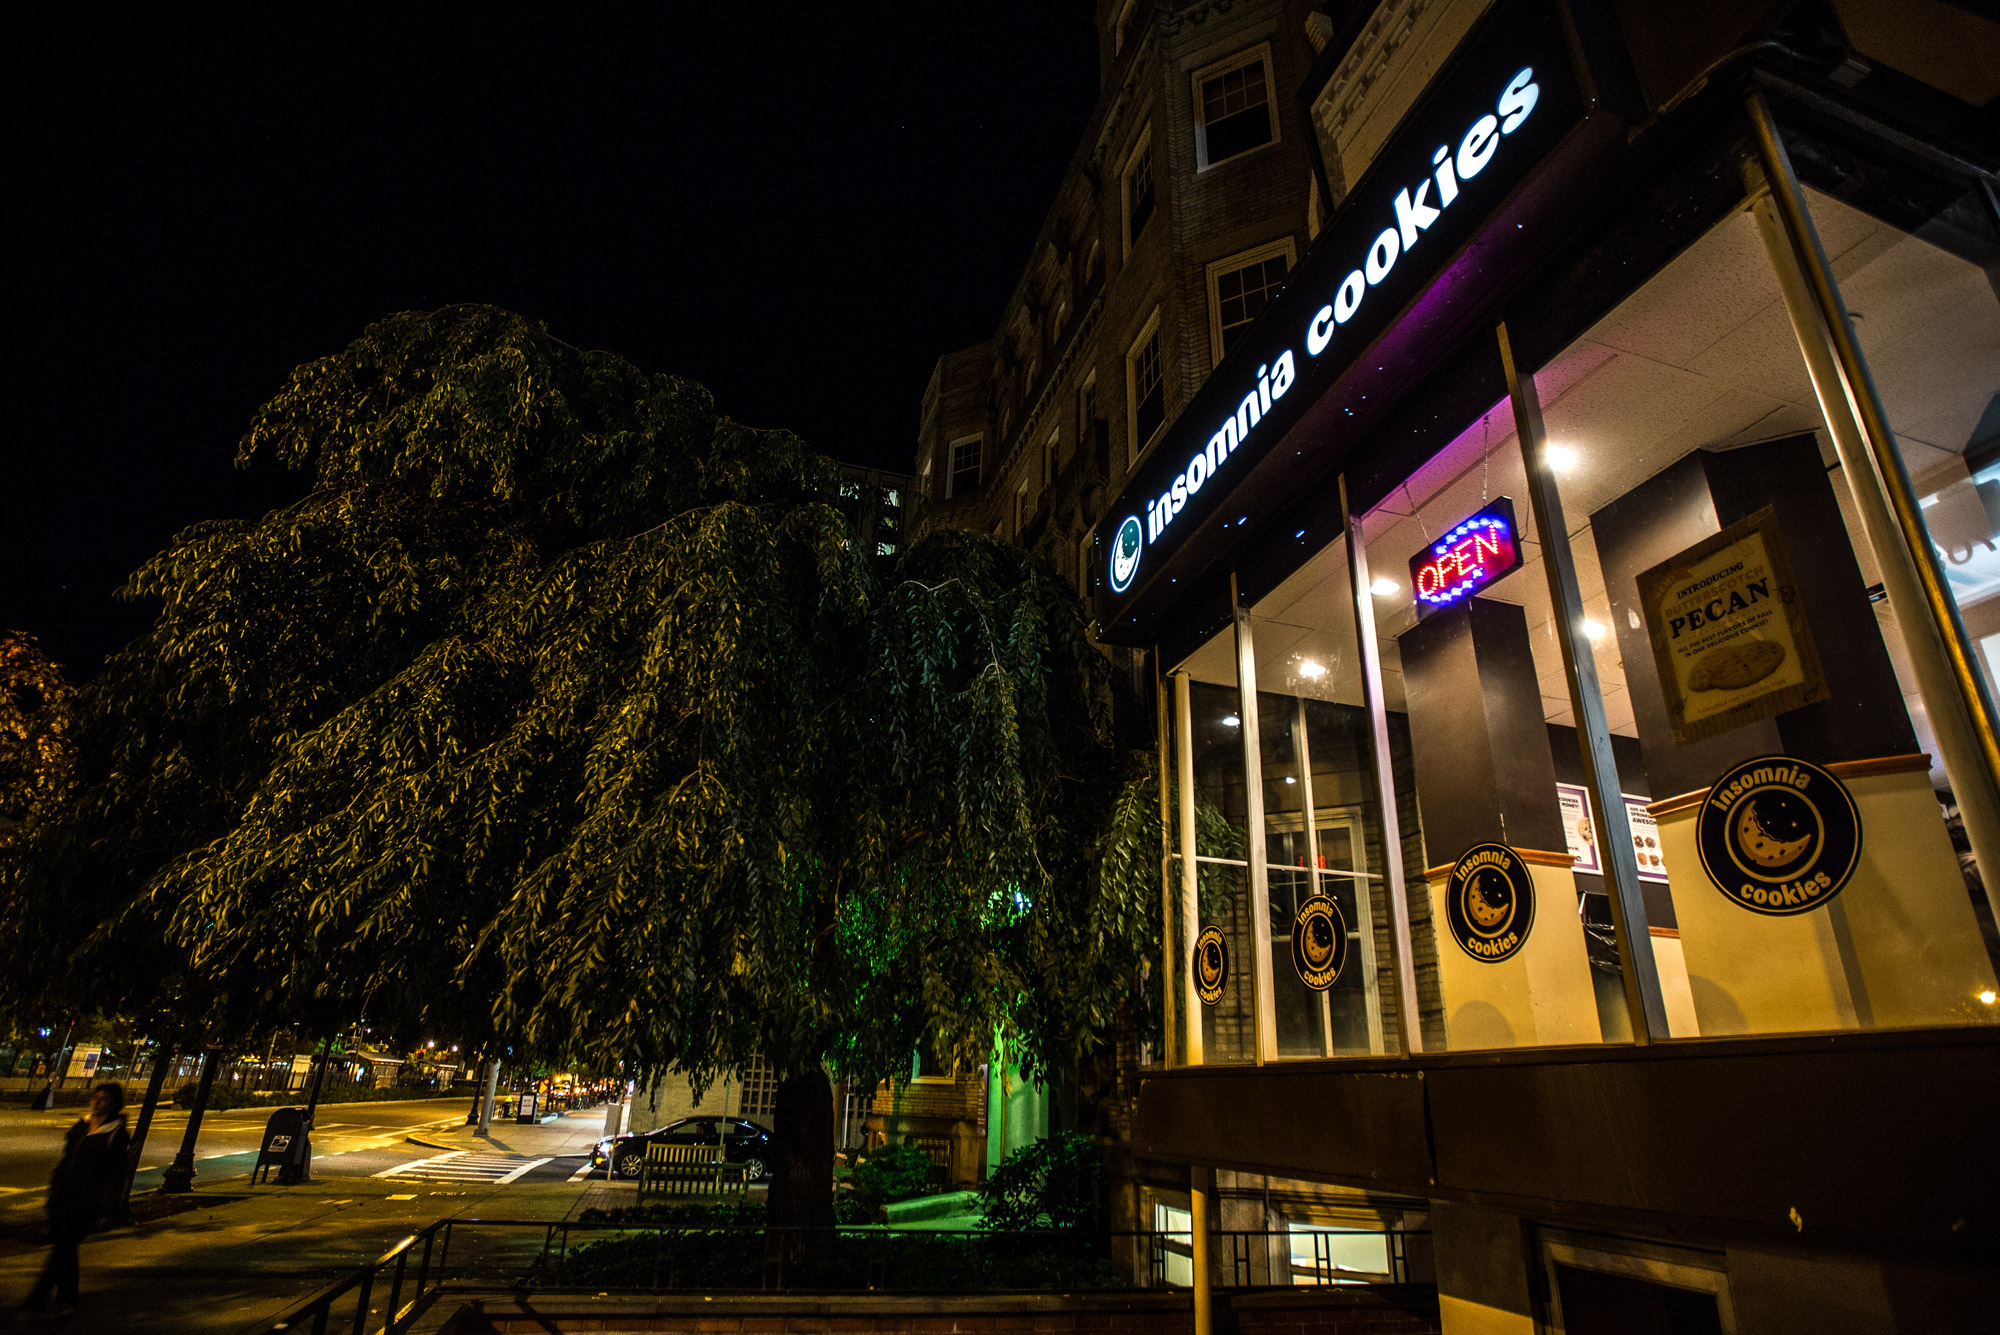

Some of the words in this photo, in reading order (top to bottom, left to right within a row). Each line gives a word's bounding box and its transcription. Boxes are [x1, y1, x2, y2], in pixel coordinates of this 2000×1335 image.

[1147, 348, 1296, 544] insomnia
[1305, 65, 1541, 357] cookies
[1417, 523, 1499, 597] OPEN
[1665, 565, 1764, 618] BUTTERSCOTCH
[1677, 561, 1744, 599] INTRODUCING
[1669, 578, 1770, 639] PECAN
[1678, 645, 1688, 654] ALL
[1690, 640, 1700, 648] THE
[1702, 633, 1716, 644] BEST
[1717, 621, 1746, 637] FLAVORS
[1746, 616, 1756, 624] OF
[1757, 609, 1773, 620] FALL
[1692, 646, 1705, 655] ONE
[1706, 632, 1740, 649] DELICIOUS
[1740, 618, 1769, 635] COOKIE!
[1711, 765, 1811, 812] insomnia
[1455, 850, 1511, 882] insomnia
[1740, 871, 1832, 907] cookies
[1297, 901, 1334, 926] insomnia
[1467, 931, 1519, 956] cookies
[1200, 987, 1222, 1002] cookies
[1303, 967, 1336, 986] cookies
